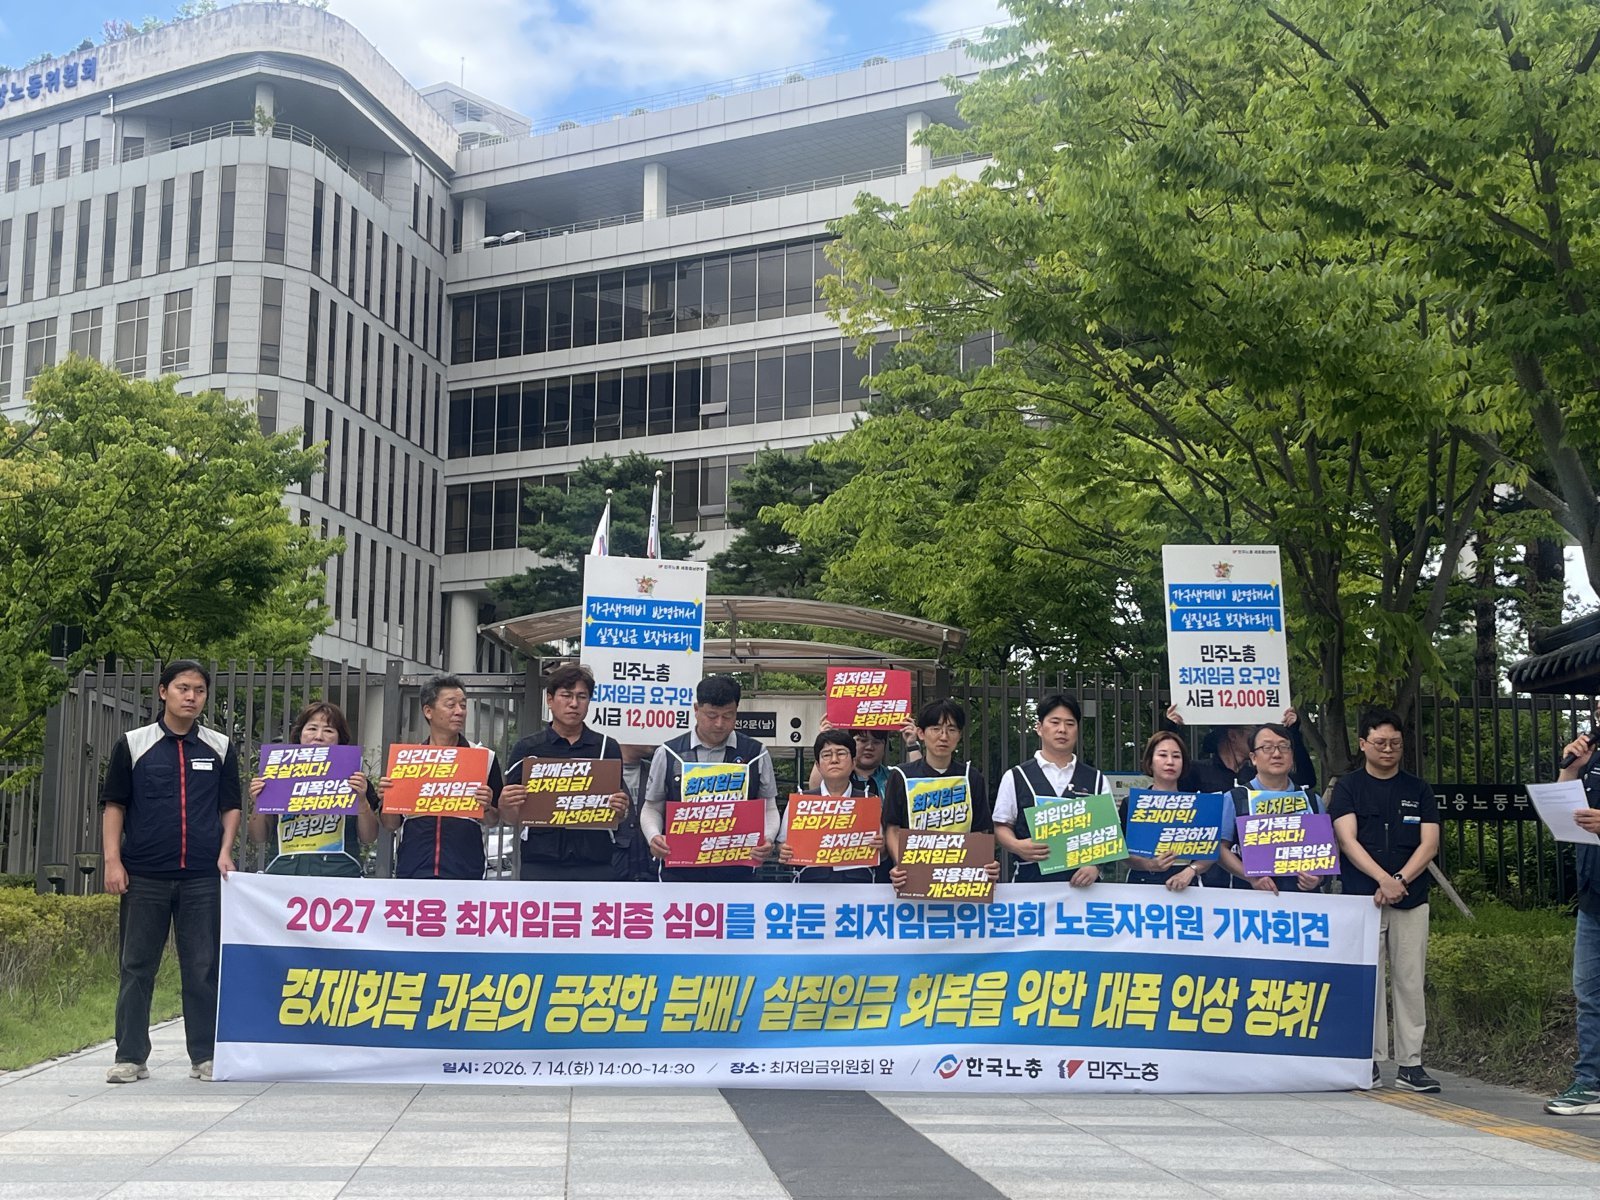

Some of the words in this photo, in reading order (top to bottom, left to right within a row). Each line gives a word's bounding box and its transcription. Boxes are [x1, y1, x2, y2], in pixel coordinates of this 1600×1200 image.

[1172, 588, 1226, 603] 가구생계비
[1231, 588, 1274, 602] 반영해서
[590, 602, 646, 618] 가구생계비
[652, 605, 696, 620] 반영해서
[1181, 612, 1222, 629] 실질임금
[1226, 612, 1274, 628] 보장하라!!
[597, 627, 638, 645] 실질임금
[1200, 645, 1256, 663] 민주노총
[613, 662, 671, 682] 민주노총
[833, 671, 886, 685] 최저임금
[1179, 667, 1235, 685] 최저임금
[1239, 667, 1280, 685] 요구안
[650, 687, 693, 706] 요구안
[829, 684, 888, 698] 대폭인상!
[1186, 689, 1214, 707] 시급
[1217, 689, 1280, 709] 12,000원
[856, 700, 908, 714] 생존권을
[592, 707, 621, 726] 시급
[626, 709, 690, 729] 12,000원
[267, 746, 330, 765] 물가폭등
[396, 748, 458, 764] 인간다운
[262, 761, 331, 780] 못살겠다!
[390, 763, 459, 779] 삶의기준!
[529, 761, 591, 779] 함께살자
[291, 779, 353, 796] 대폭인상
[526, 776, 593, 793] 최저임금!
[685, 772, 746, 795] 최저임금
[287, 793, 357, 812] 쟁취하자!
[912, 784, 966, 812] 최저임금
[1136, 794, 1197, 809] 경제성장
[1255, 797, 1308, 815] 최저임금
[1434, 793, 1529, 811] 고용노동부
[673, 803, 735, 820] 최저임금
[796, 800, 856, 815] 인간다운
[913, 803, 969, 830] 대폭인상
[1034, 799, 1086, 826] 최임인상
[1130, 809, 1197, 824] 초과이익!
[549, 809, 615, 825] 개선하라!
[669, 817, 737, 835] 대폭인상!
[790, 814, 857, 830] 삶의기준!
[1035, 812, 1092, 840] 내수진작!
[1245, 815, 1301, 833] 물가폭등
[281, 814, 341, 842] 대폭인상
[1159, 826, 1218, 842] 공정하게
[700, 832, 760, 851] 생존권을
[905, 834, 965, 850] 함께살자
[1066, 825, 1118, 852] 골목상권
[1243, 828, 1306, 847] 못살겠다!
[815, 846, 876, 864] 인상하라!
[901, 849, 967, 865] 최저임금!
[1066, 838, 1123, 868] 활성화다!
[1275, 843, 1333, 860] 대폭인상
[1273, 855, 1336, 874] 쟁취하자!
[927, 882, 992, 898] 개선하라!
[286, 896, 375, 934] 2027
[383, 899, 447, 937] 적용
[455, 900, 583, 938] 최저임금
[591, 901, 654, 939] 최종
[662, 902, 755, 940] 심의를
[764, 902, 825, 940] 앞둔
[834, 901, 1046, 940] 최저임금위원회
[1055, 901, 1204, 941] 노동자위원
[1213, 907, 1330, 948] 기자회견
[278, 968, 427, 1031] 경제회복
[426, 973, 543, 1033] 과실의
[544, 974, 657, 1033] 공정한
[660, 974, 756, 1033] 분배!
[758, 975, 900, 1032] 실질임금
[899, 971, 1008, 1028] 회복을
[1012, 968, 1088, 1029] 위한
[1091, 972, 1163, 1031] 대폭
[1168, 974, 1240, 1034] 인상
[1244, 979, 1331, 1040] 쟁취!
[442, 1062, 479, 1074] 일시:
[599, 1062, 695, 1075] 14:00~14:30
[730, 1061, 766, 1074] 장소:
[769, 1059, 874, 1075] 최저임금위원회
[879, 1058, 895, 1075] 앞
[965, 1057, 1043, 1079] 한국노총
[1087, 1061, 1159, 1081] 민주노총
